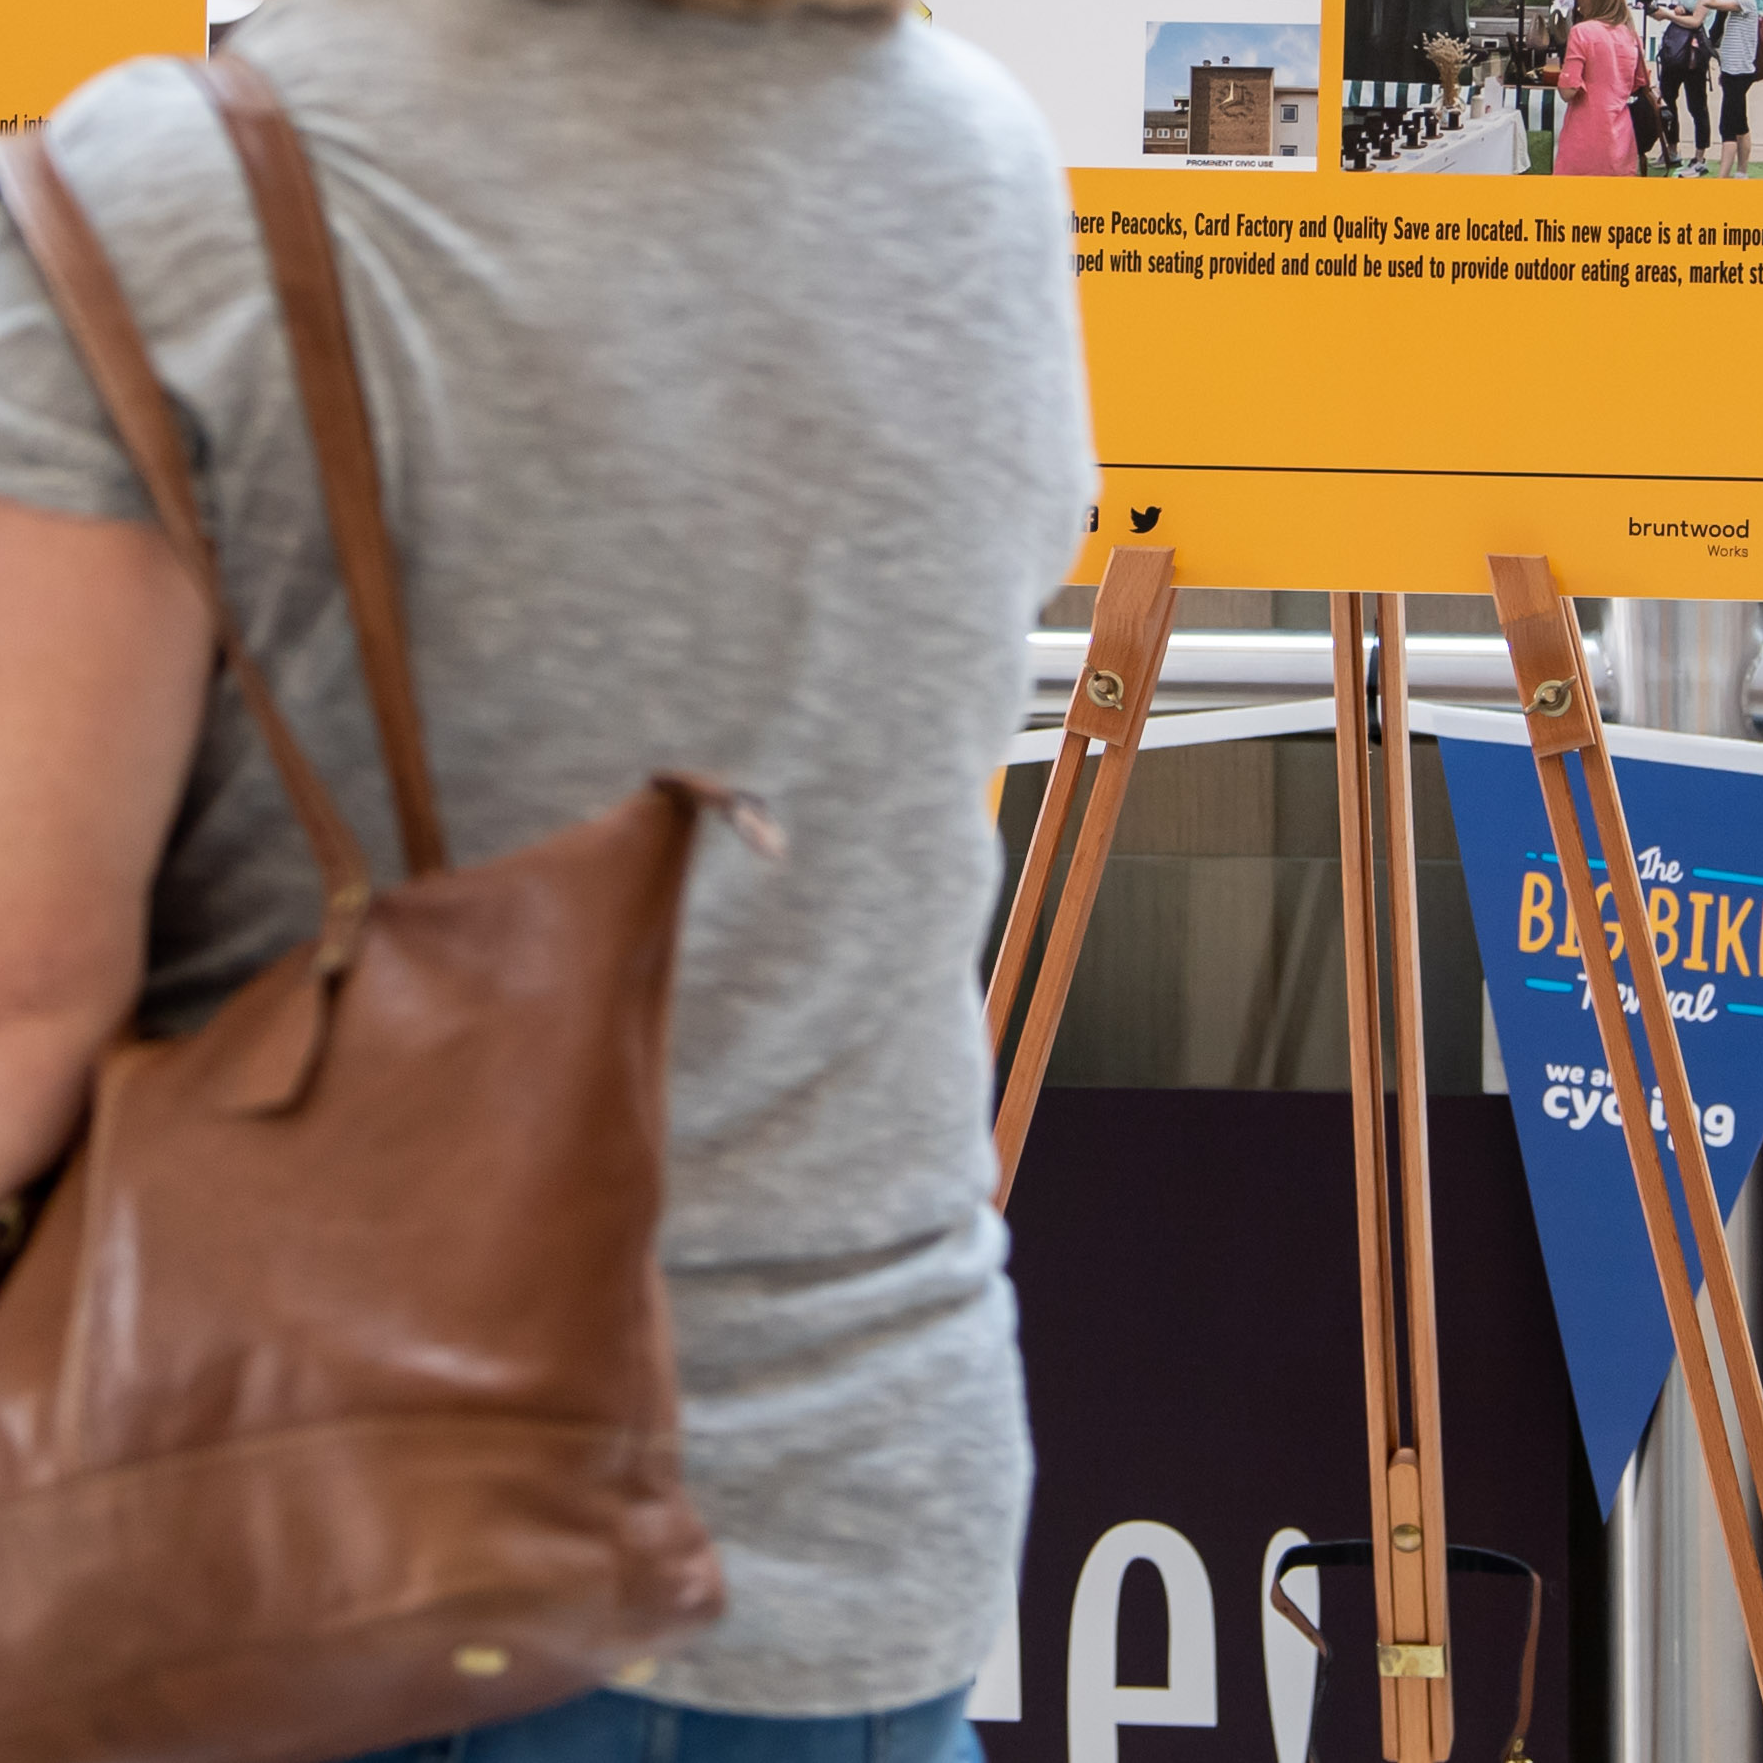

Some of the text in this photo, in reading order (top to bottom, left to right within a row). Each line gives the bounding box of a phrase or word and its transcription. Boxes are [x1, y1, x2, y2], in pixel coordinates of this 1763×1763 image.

[1111, 211, 1187, 239] Peacocks,
[1194, 212, 1229, 236] Card
[1236, 213, 1293, 243] Factory
[1299, 214, 1326, 238] and
[1333, 214, 1387, 245] Quality
[1393, 216, 1429, 240] Save
[1435, 222, 1460, 240] are
[1466, 217, 1528, 242] located.
[1534, 218, 1565, 242] This
[1571, 225, 1601, 243] new
[1607, 225, 1651, 250] space
[1658, 221, 1670, 244] is
[1677, 223, 1692, 245] at
[1698, 227, 1716, 245] an
[1628, 517, 1750, 538] bruntwood
[1707, 545, 1748, 557] Works
[1637, 846, 1684, 884] The
[1545, 1063, 1586, 1085] we
